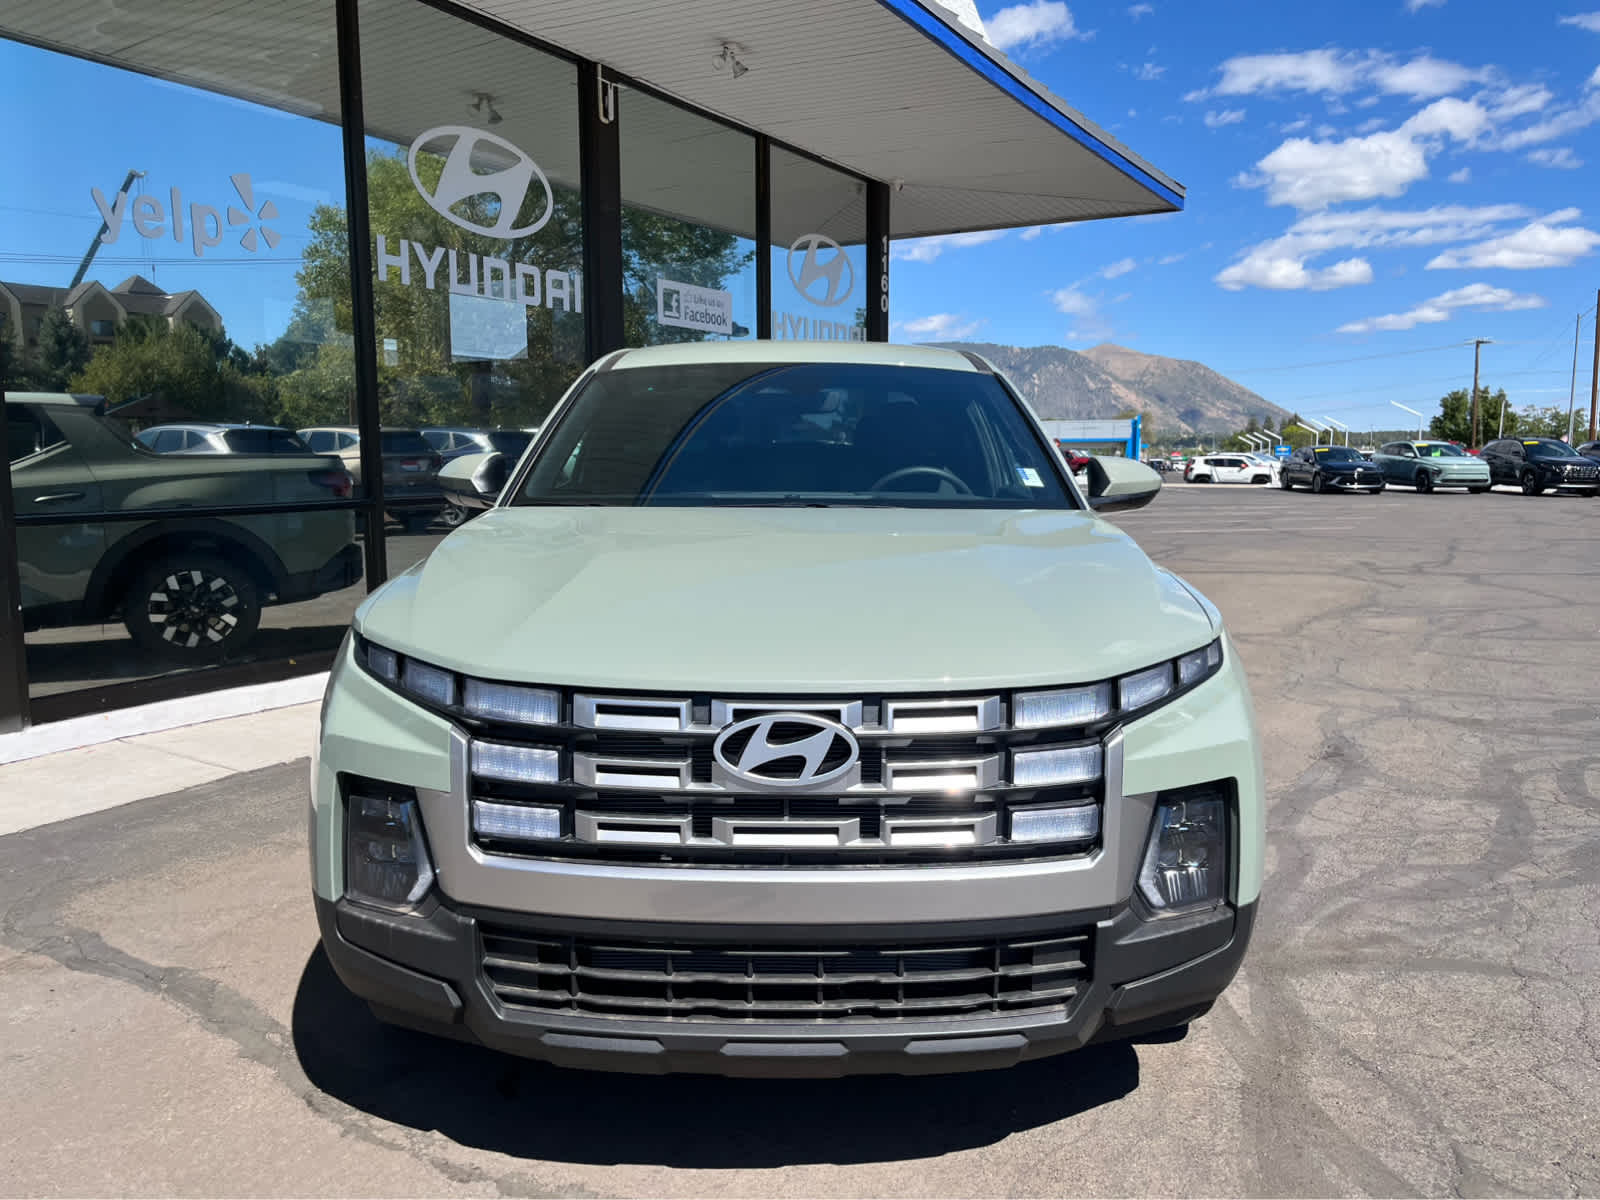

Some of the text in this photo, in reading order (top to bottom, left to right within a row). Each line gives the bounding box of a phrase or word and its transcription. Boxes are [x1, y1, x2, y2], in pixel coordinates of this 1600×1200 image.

[91, 186, 223, 257] yelp
[376, 234, 583, 313] HYUNDAI
[880, 234, 889, 313] 1160
[684, 304, 728, 327] Facebook
